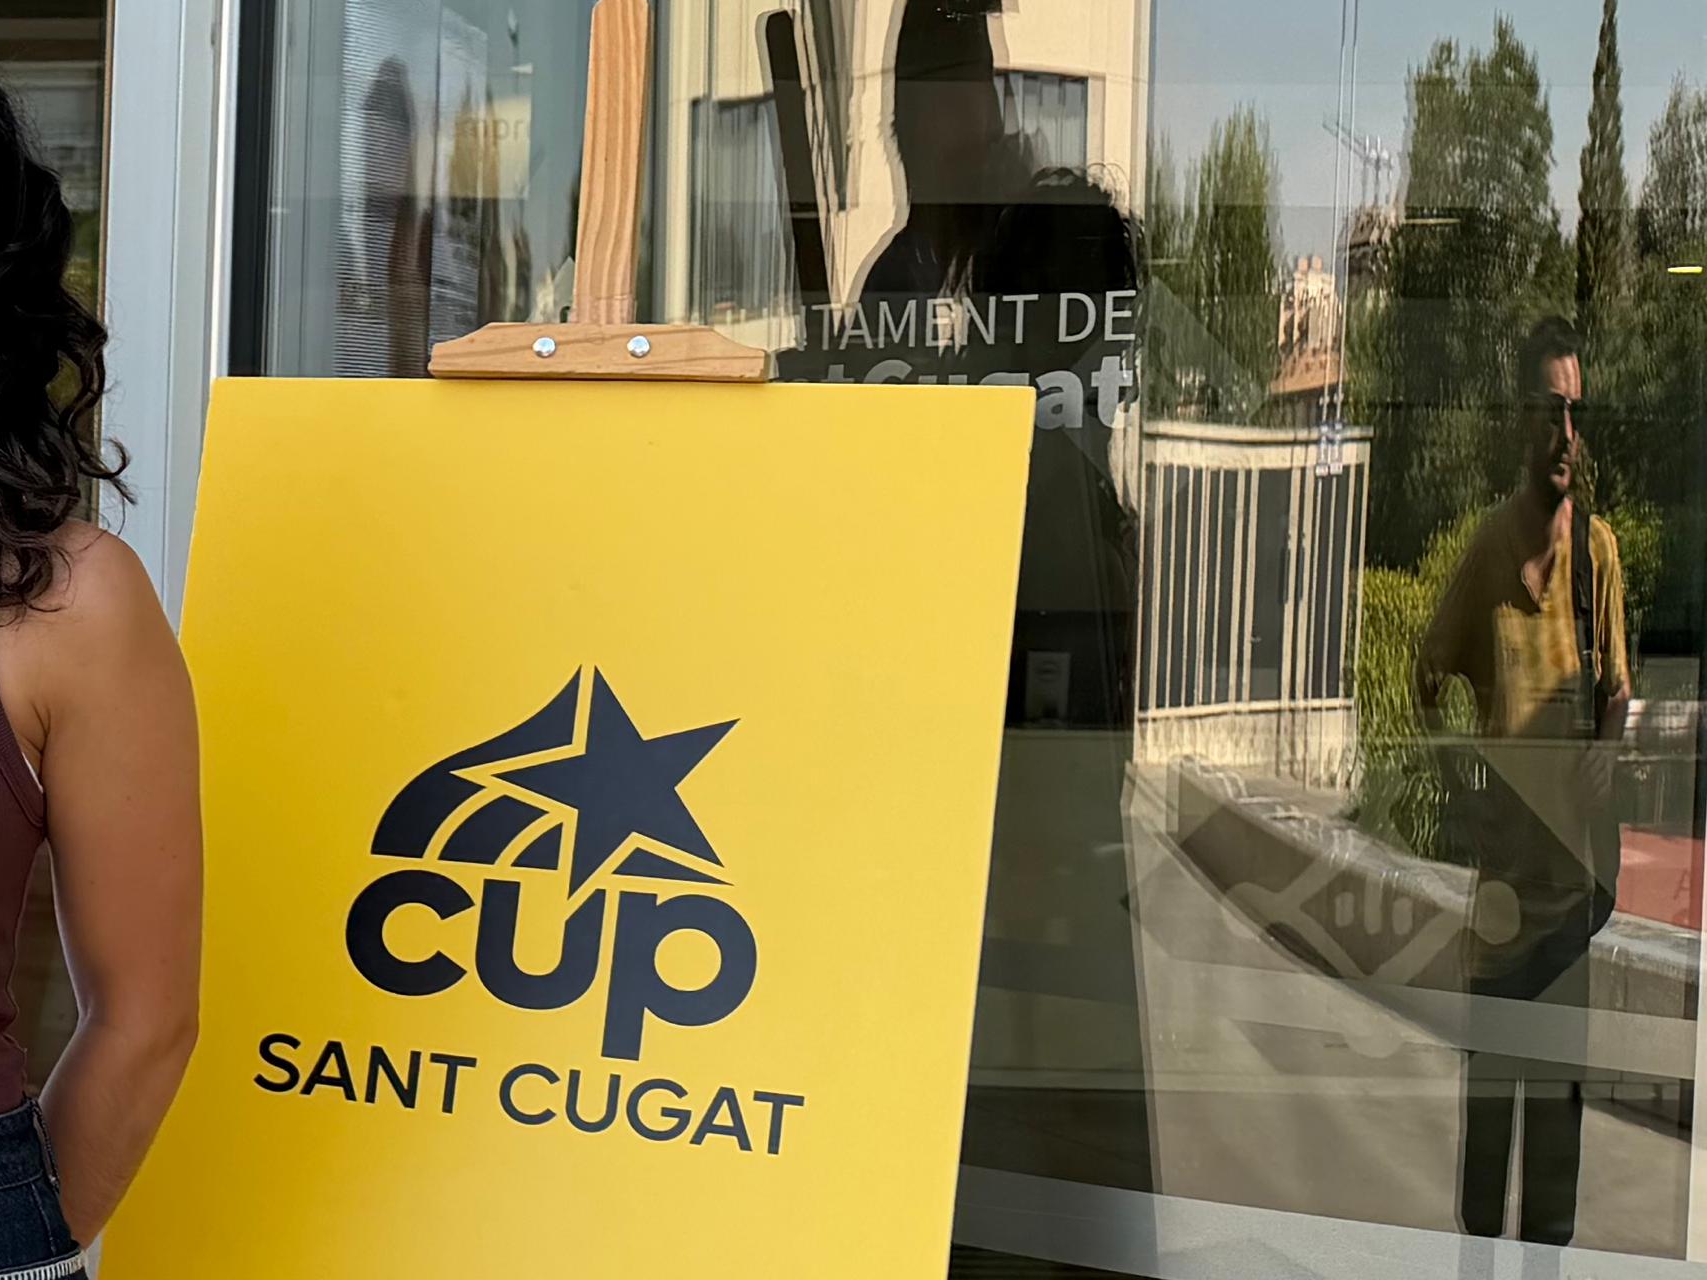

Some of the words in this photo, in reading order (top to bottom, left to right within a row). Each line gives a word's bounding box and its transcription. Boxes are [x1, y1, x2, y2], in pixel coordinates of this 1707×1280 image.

[1058, 289, 1136, 344] DE
[253, 1032, 477, 1114] SANT
[498, 1062, 805, 1156] CUGAT
